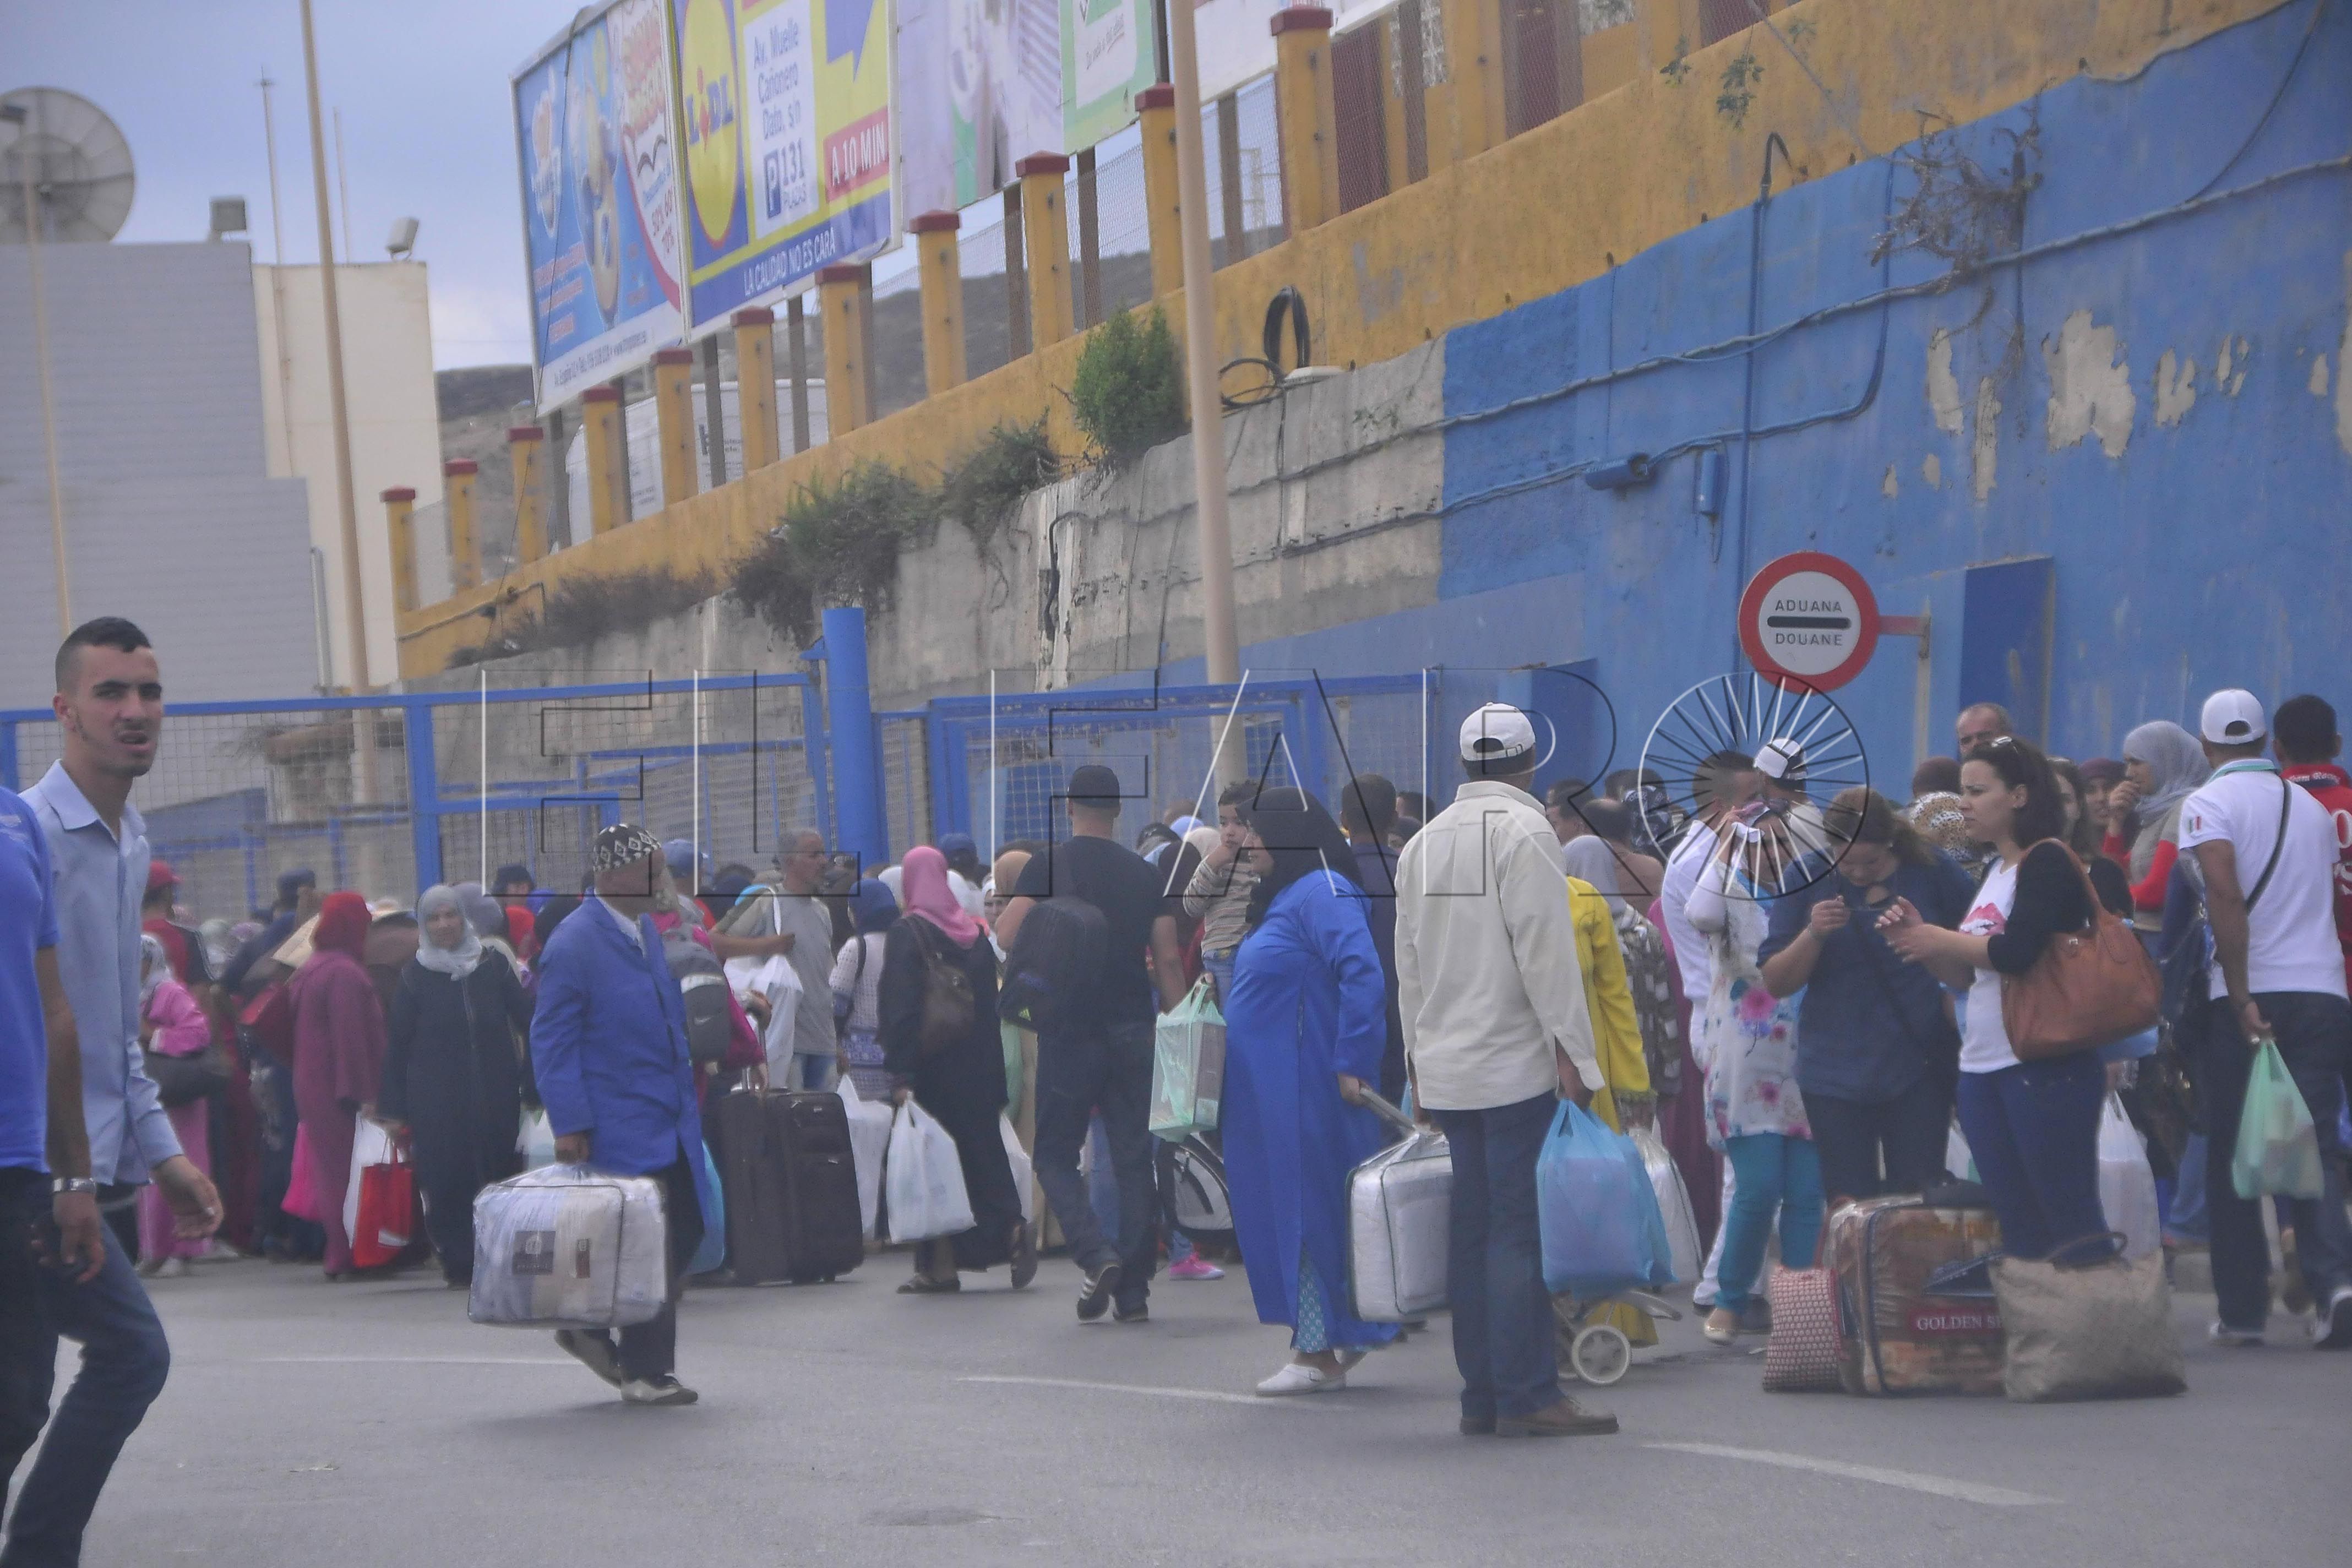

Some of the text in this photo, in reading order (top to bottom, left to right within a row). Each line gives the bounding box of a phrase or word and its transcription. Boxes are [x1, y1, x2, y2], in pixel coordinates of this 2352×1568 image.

[781, 138, 805, 187] 131
[832, 121, 886, 187] A 10 MIN
[744, 226, 836, 296] LA CALIDAD NO ES CARA
[1774, 599, 1842, 613] ADUANA
[1775, 633, 1843, 646] DOUANE
[1917, 1315, 1983, 1331] GOLDEN
